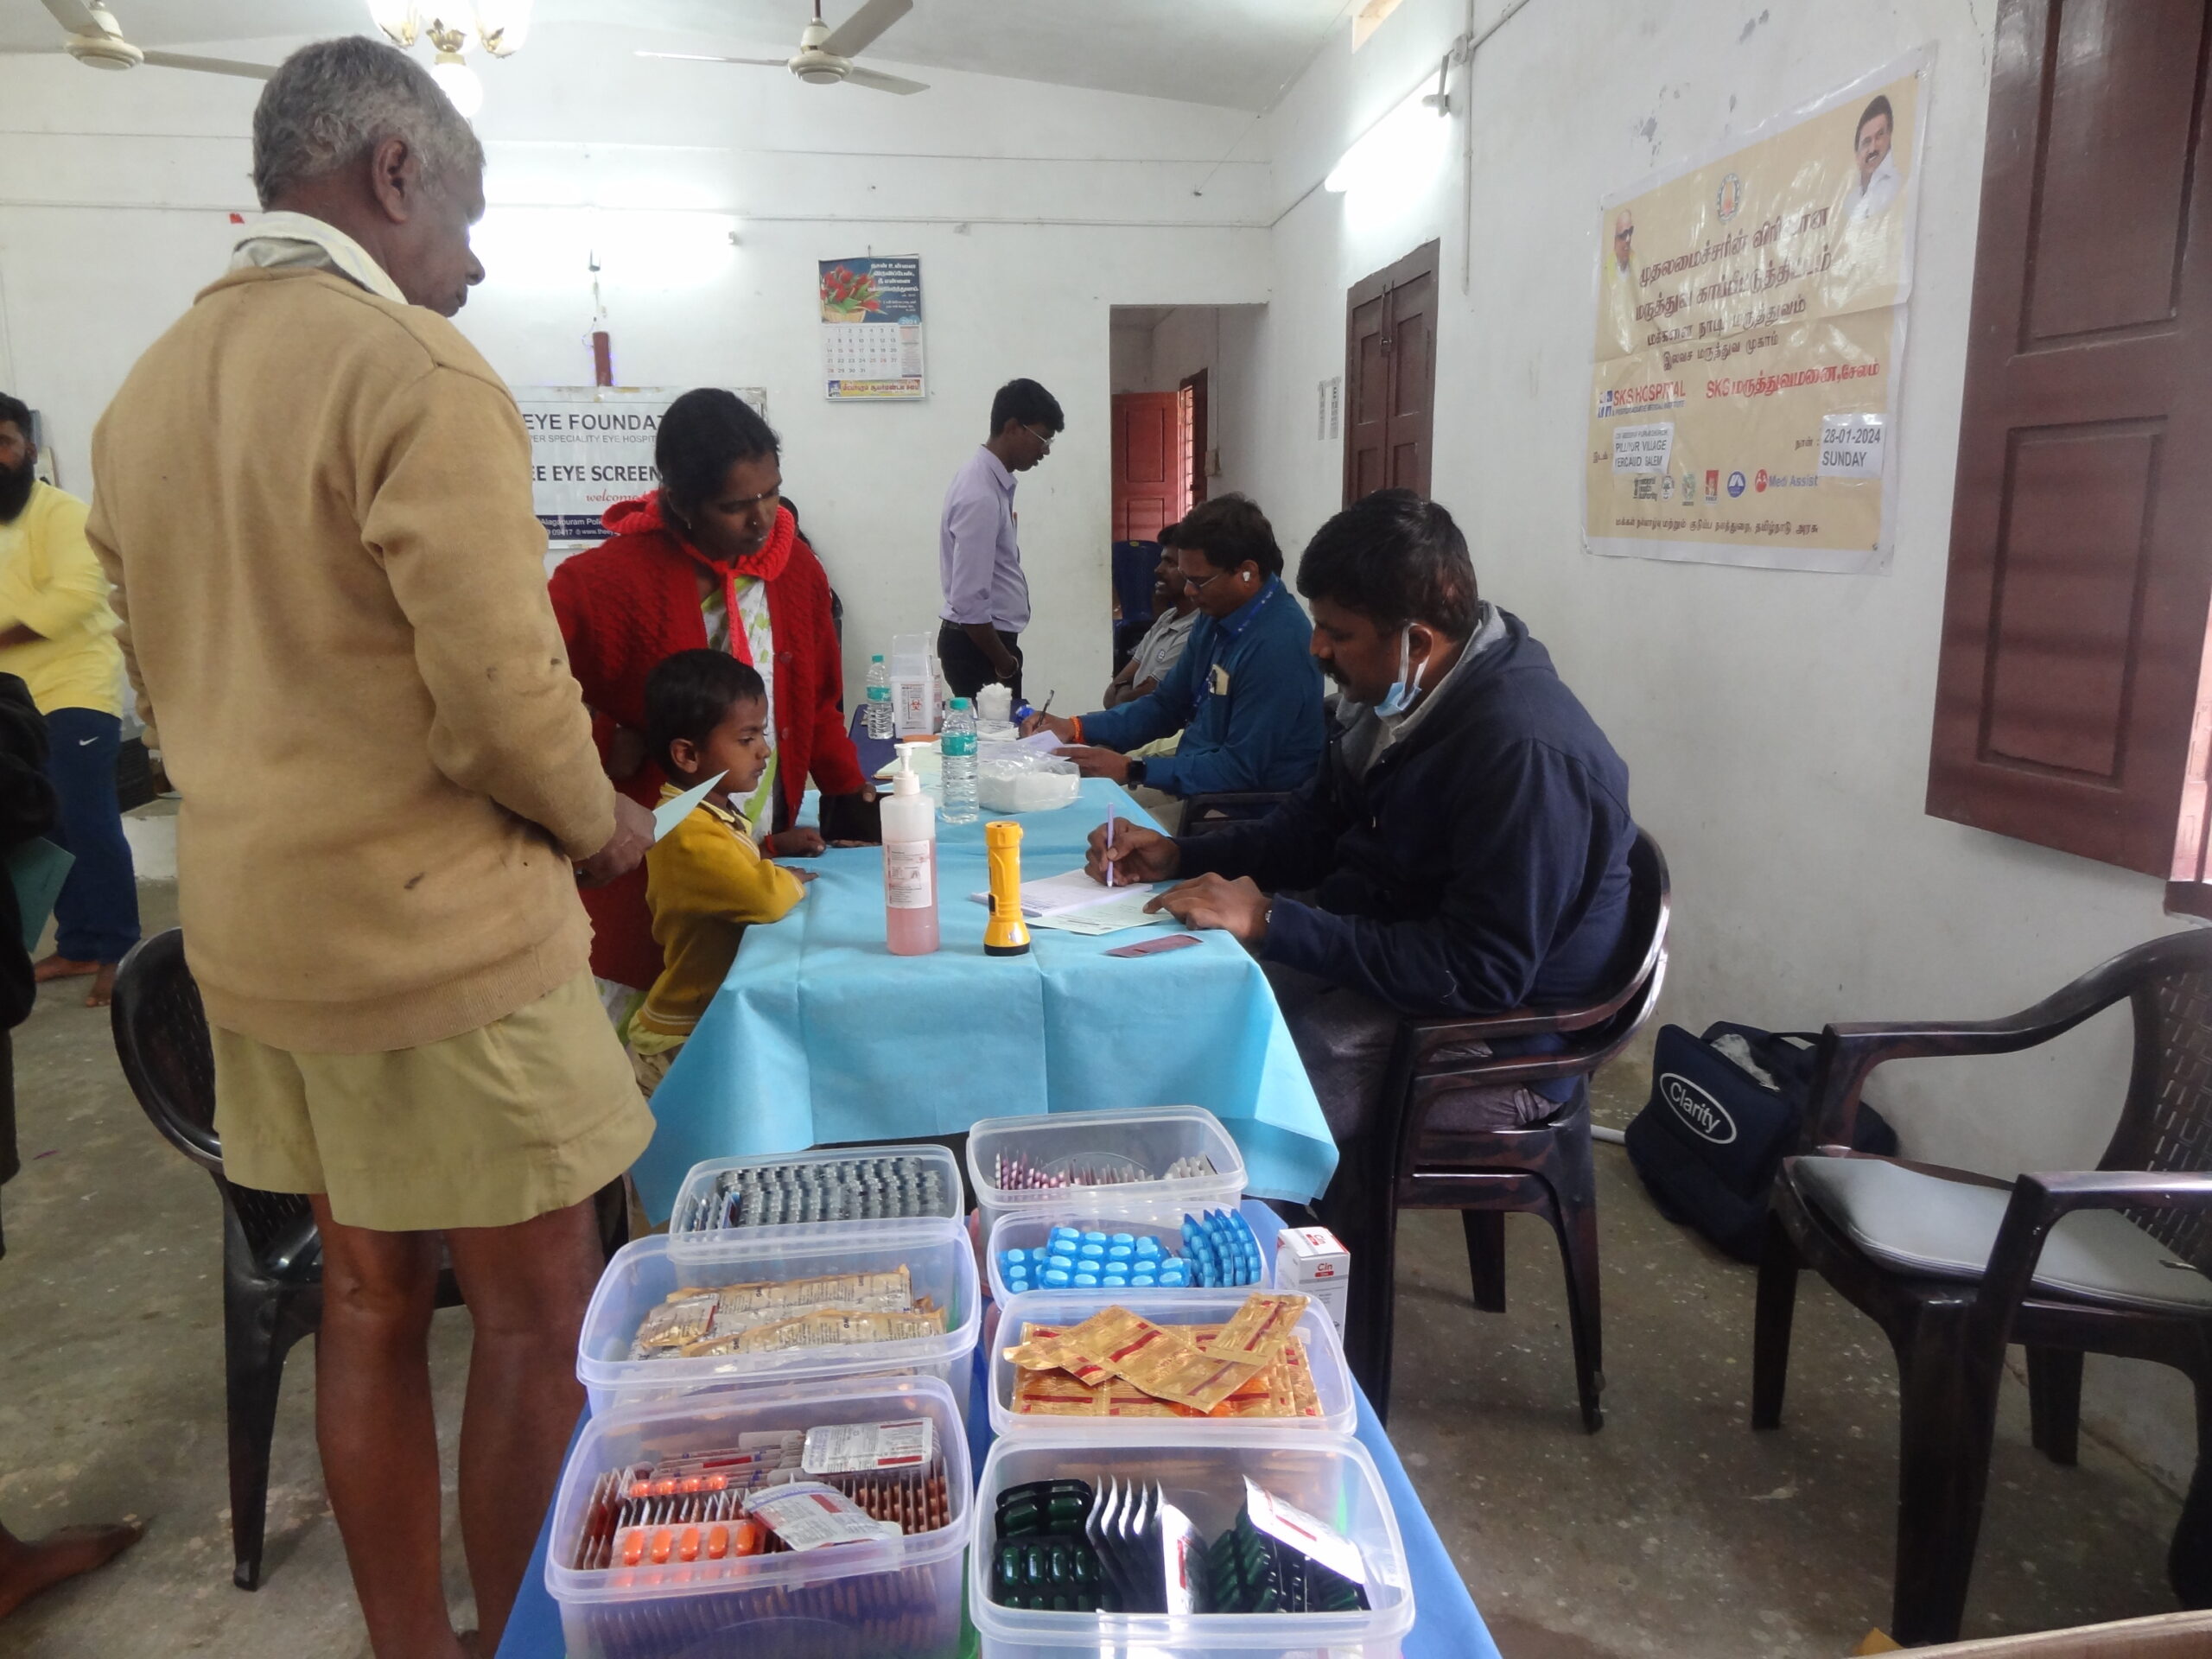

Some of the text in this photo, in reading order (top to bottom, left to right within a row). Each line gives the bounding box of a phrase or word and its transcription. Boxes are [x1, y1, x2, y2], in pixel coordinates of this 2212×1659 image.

[1639, 207, 1830, 287] முதலமைச்சரின் விரிான
[1636, 291, 1692, 322] மருத்துவ
[1699, 318, 1724, 340] நாடி
[1732, 295, 1806, 330] மருத்துவம்
[1662, 330, 1778, 371] இலவச மருத்துவ முகாம்
[1706, 378, 1729, 398] SKS
[1612, 388, 1633, 406] SKS
[523, 414, 563, 429] EYE
[531, 435, 546, 443] ER
[548, 435, 601, 443] SPECIALITY
[602, 435, 621, 443] EYE
[1823, 429, 1880, 444] 28-01-2024
[1641, 440, 1667, 451] VILLAGE
[1822, 451, 1866, 467] SUNDAY
[553, 466, 586, 481] EYE
[1789, 475, 1819, 487] Assist
[586, 489, 639, 502] welcome
[1669, 1082, 1721, 1134] Clarity
